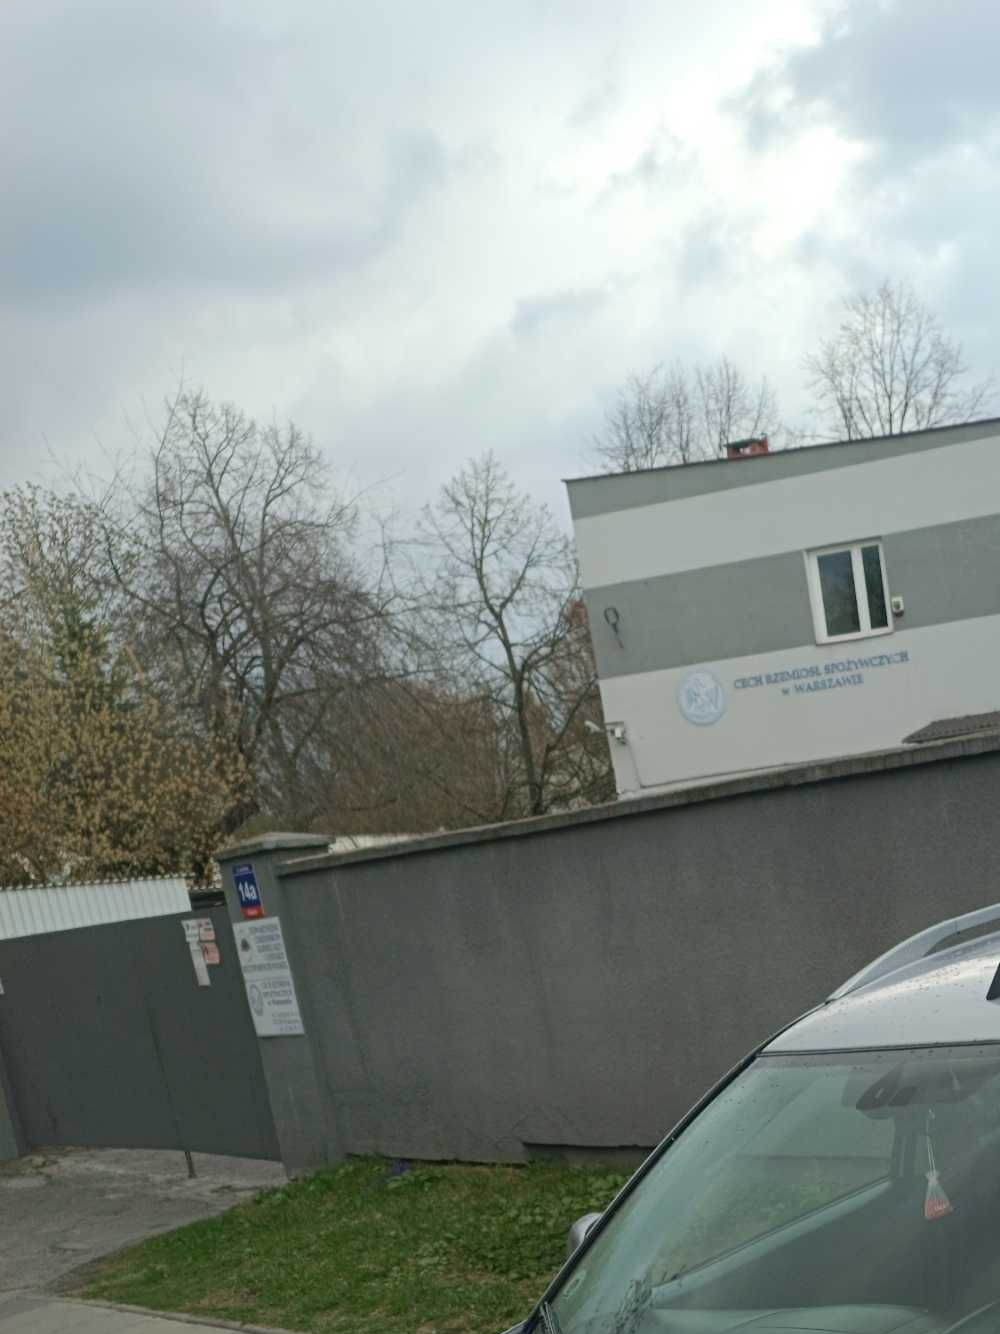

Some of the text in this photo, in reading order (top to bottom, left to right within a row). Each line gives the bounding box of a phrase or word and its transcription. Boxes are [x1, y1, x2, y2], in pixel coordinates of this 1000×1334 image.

[734, 675, 763, 690] CECH
[794, 674, 864, 693] WARSZAWIE
[239, 882, 258, 901] 14a
